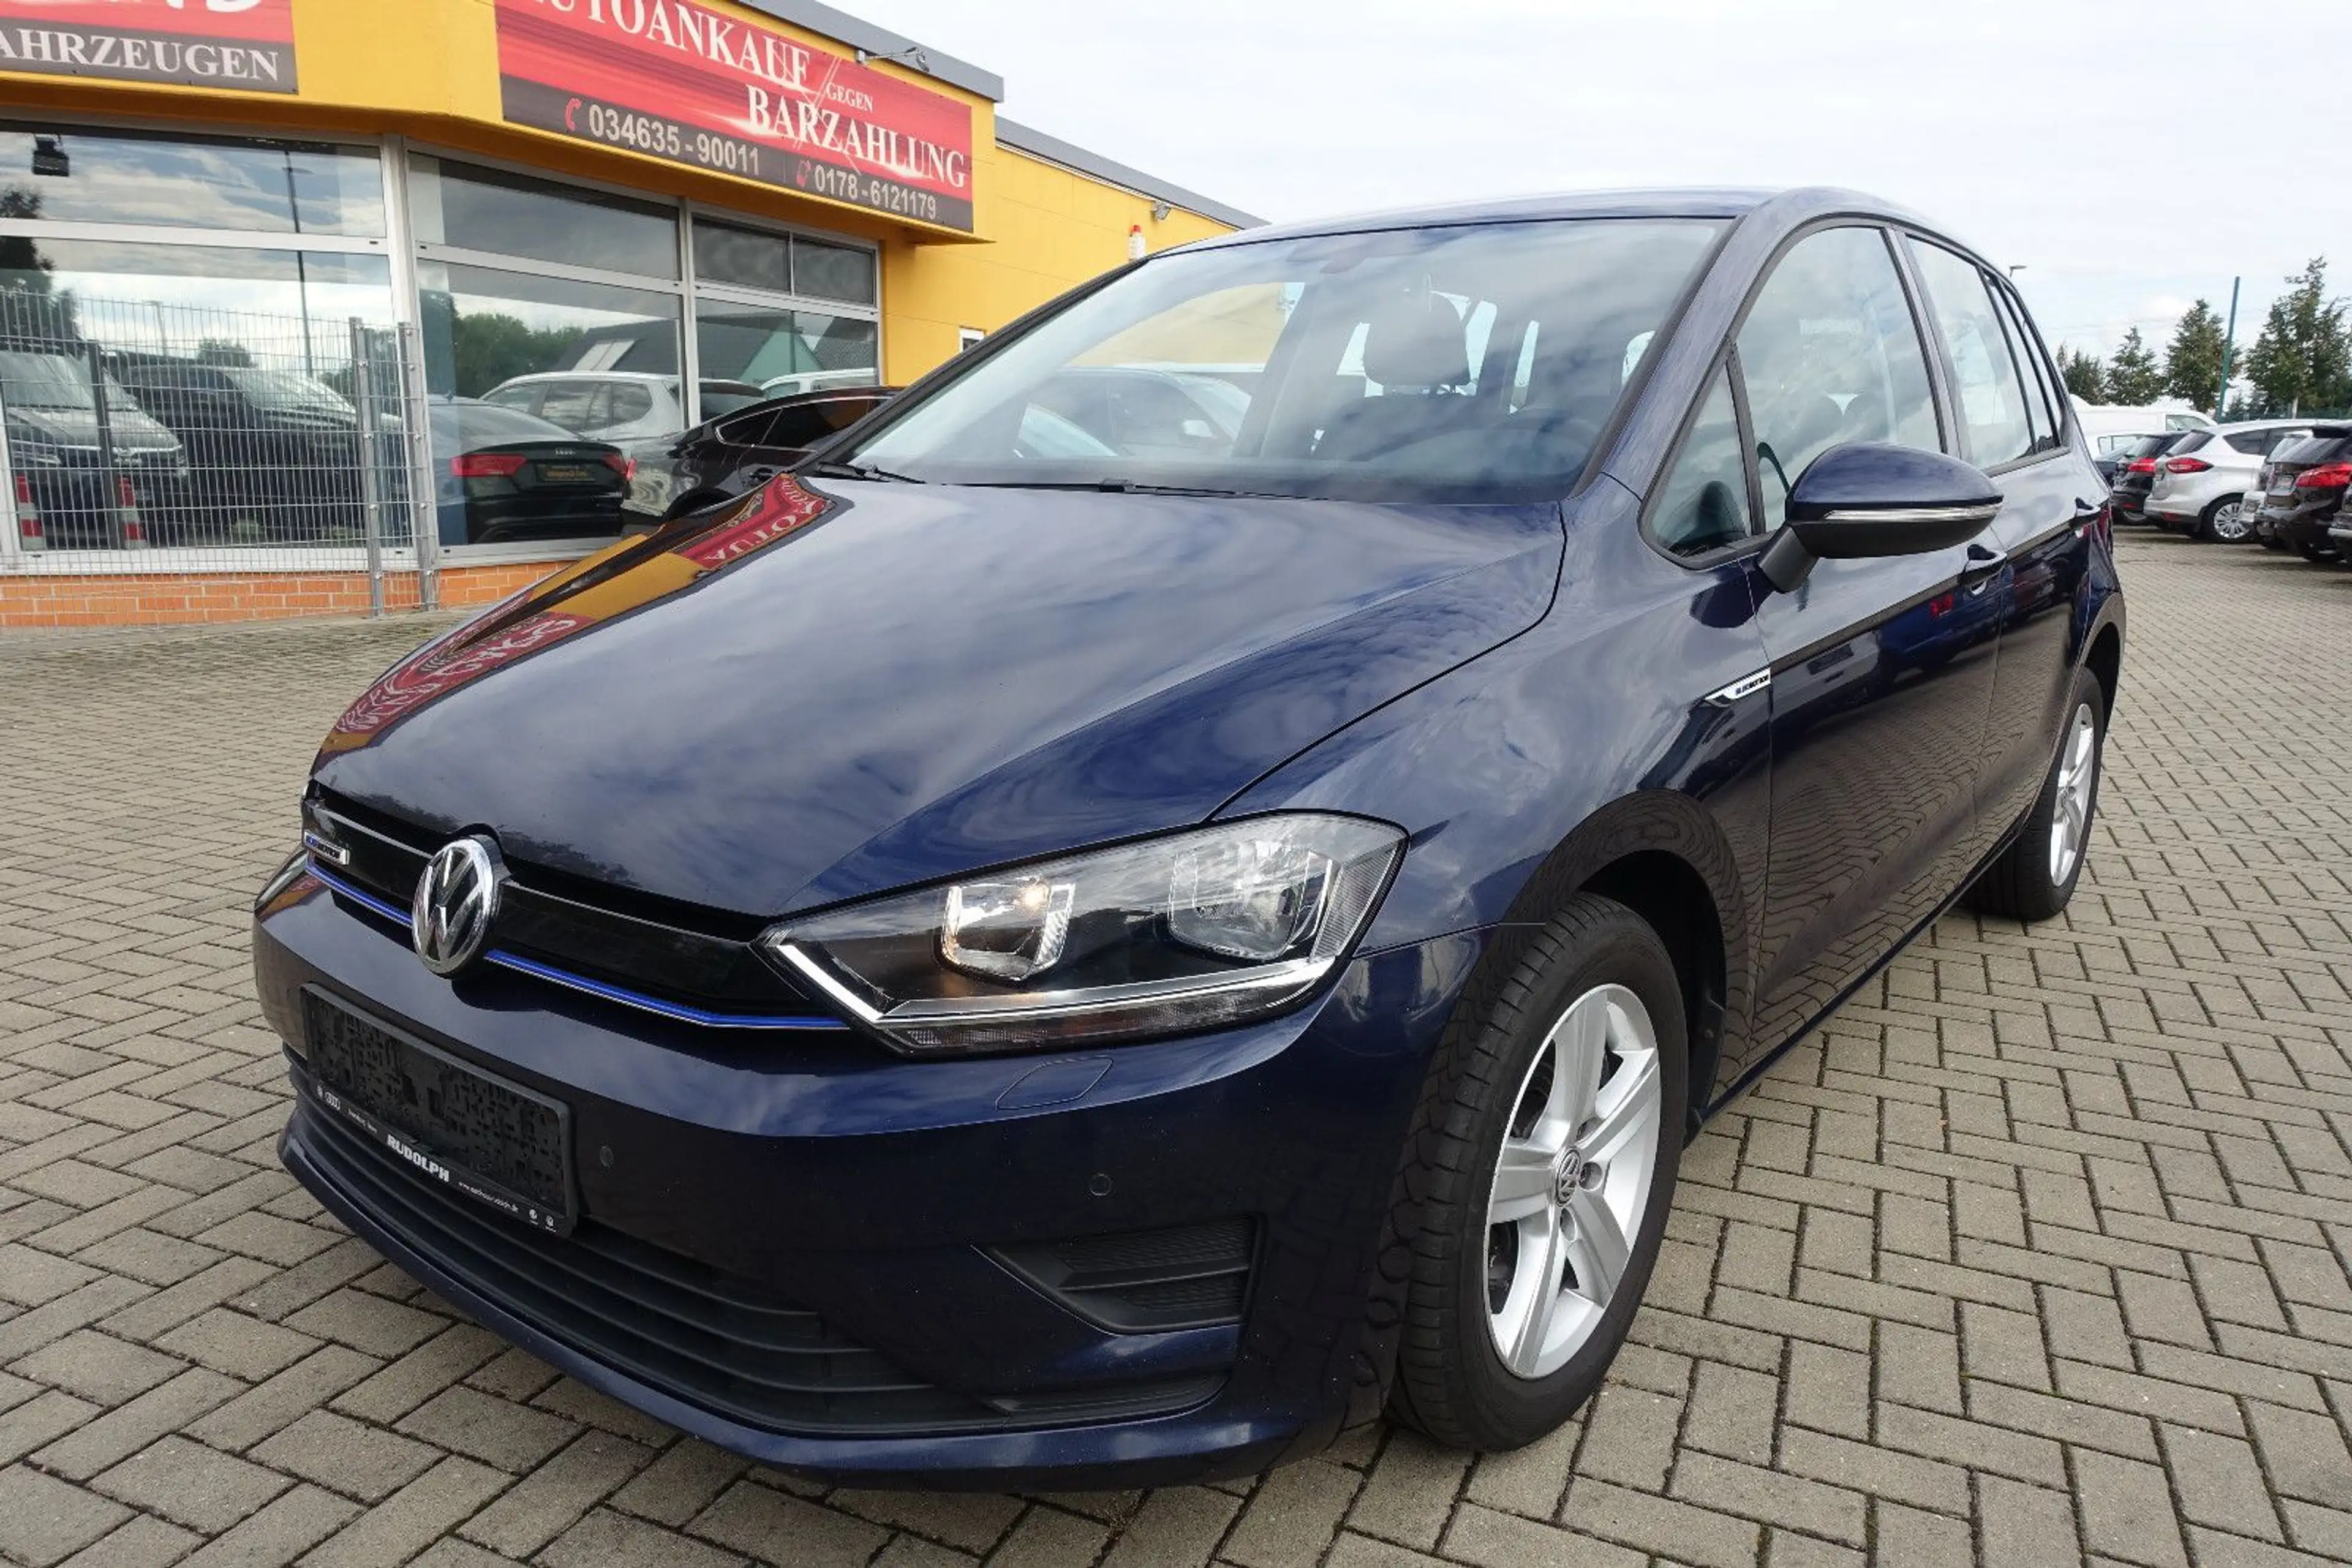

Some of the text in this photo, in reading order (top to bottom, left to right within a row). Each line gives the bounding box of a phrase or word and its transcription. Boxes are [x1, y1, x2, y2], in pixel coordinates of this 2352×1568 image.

[827, 81, 873, 113] GEGEN
[745, 83, 966, 188] BARZAHLUNG
[386, 1134, 450, 1183] RUDOLPH
